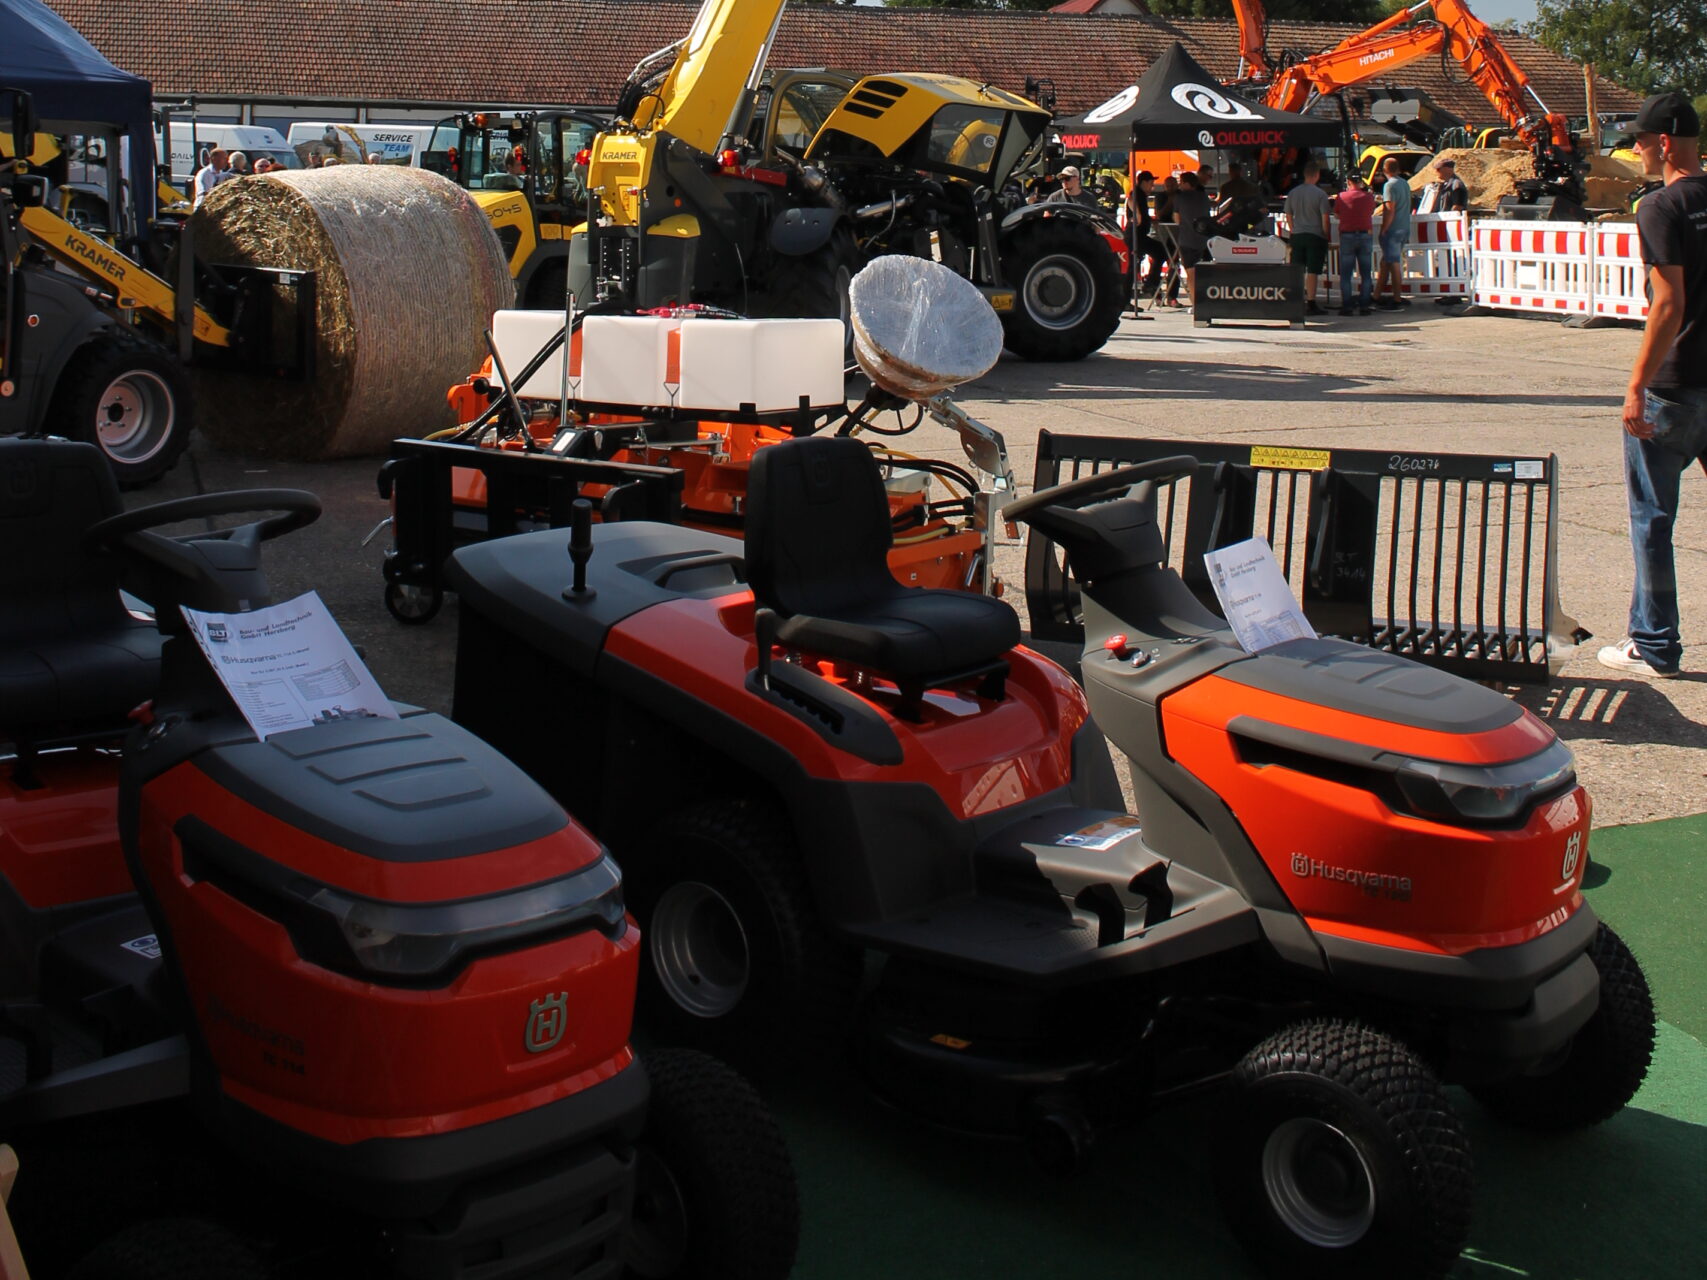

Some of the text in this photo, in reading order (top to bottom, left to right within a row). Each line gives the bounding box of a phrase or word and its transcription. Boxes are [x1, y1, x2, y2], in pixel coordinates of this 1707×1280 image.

[1359, 47, 1395, 67] HITACHI
[373, 133, 414, 143] SERVICE
[1216, 130, 1285, 146] OILQUICK
[383, 143, 411, 153] TEAM
[601, 151, 637, 160] KRAMER
[65, 234, 126, 282] KRAMER
[1206, 285, 1286, 301] OILQUICK
[1310, 858, 1412, 891] Husqvarna
